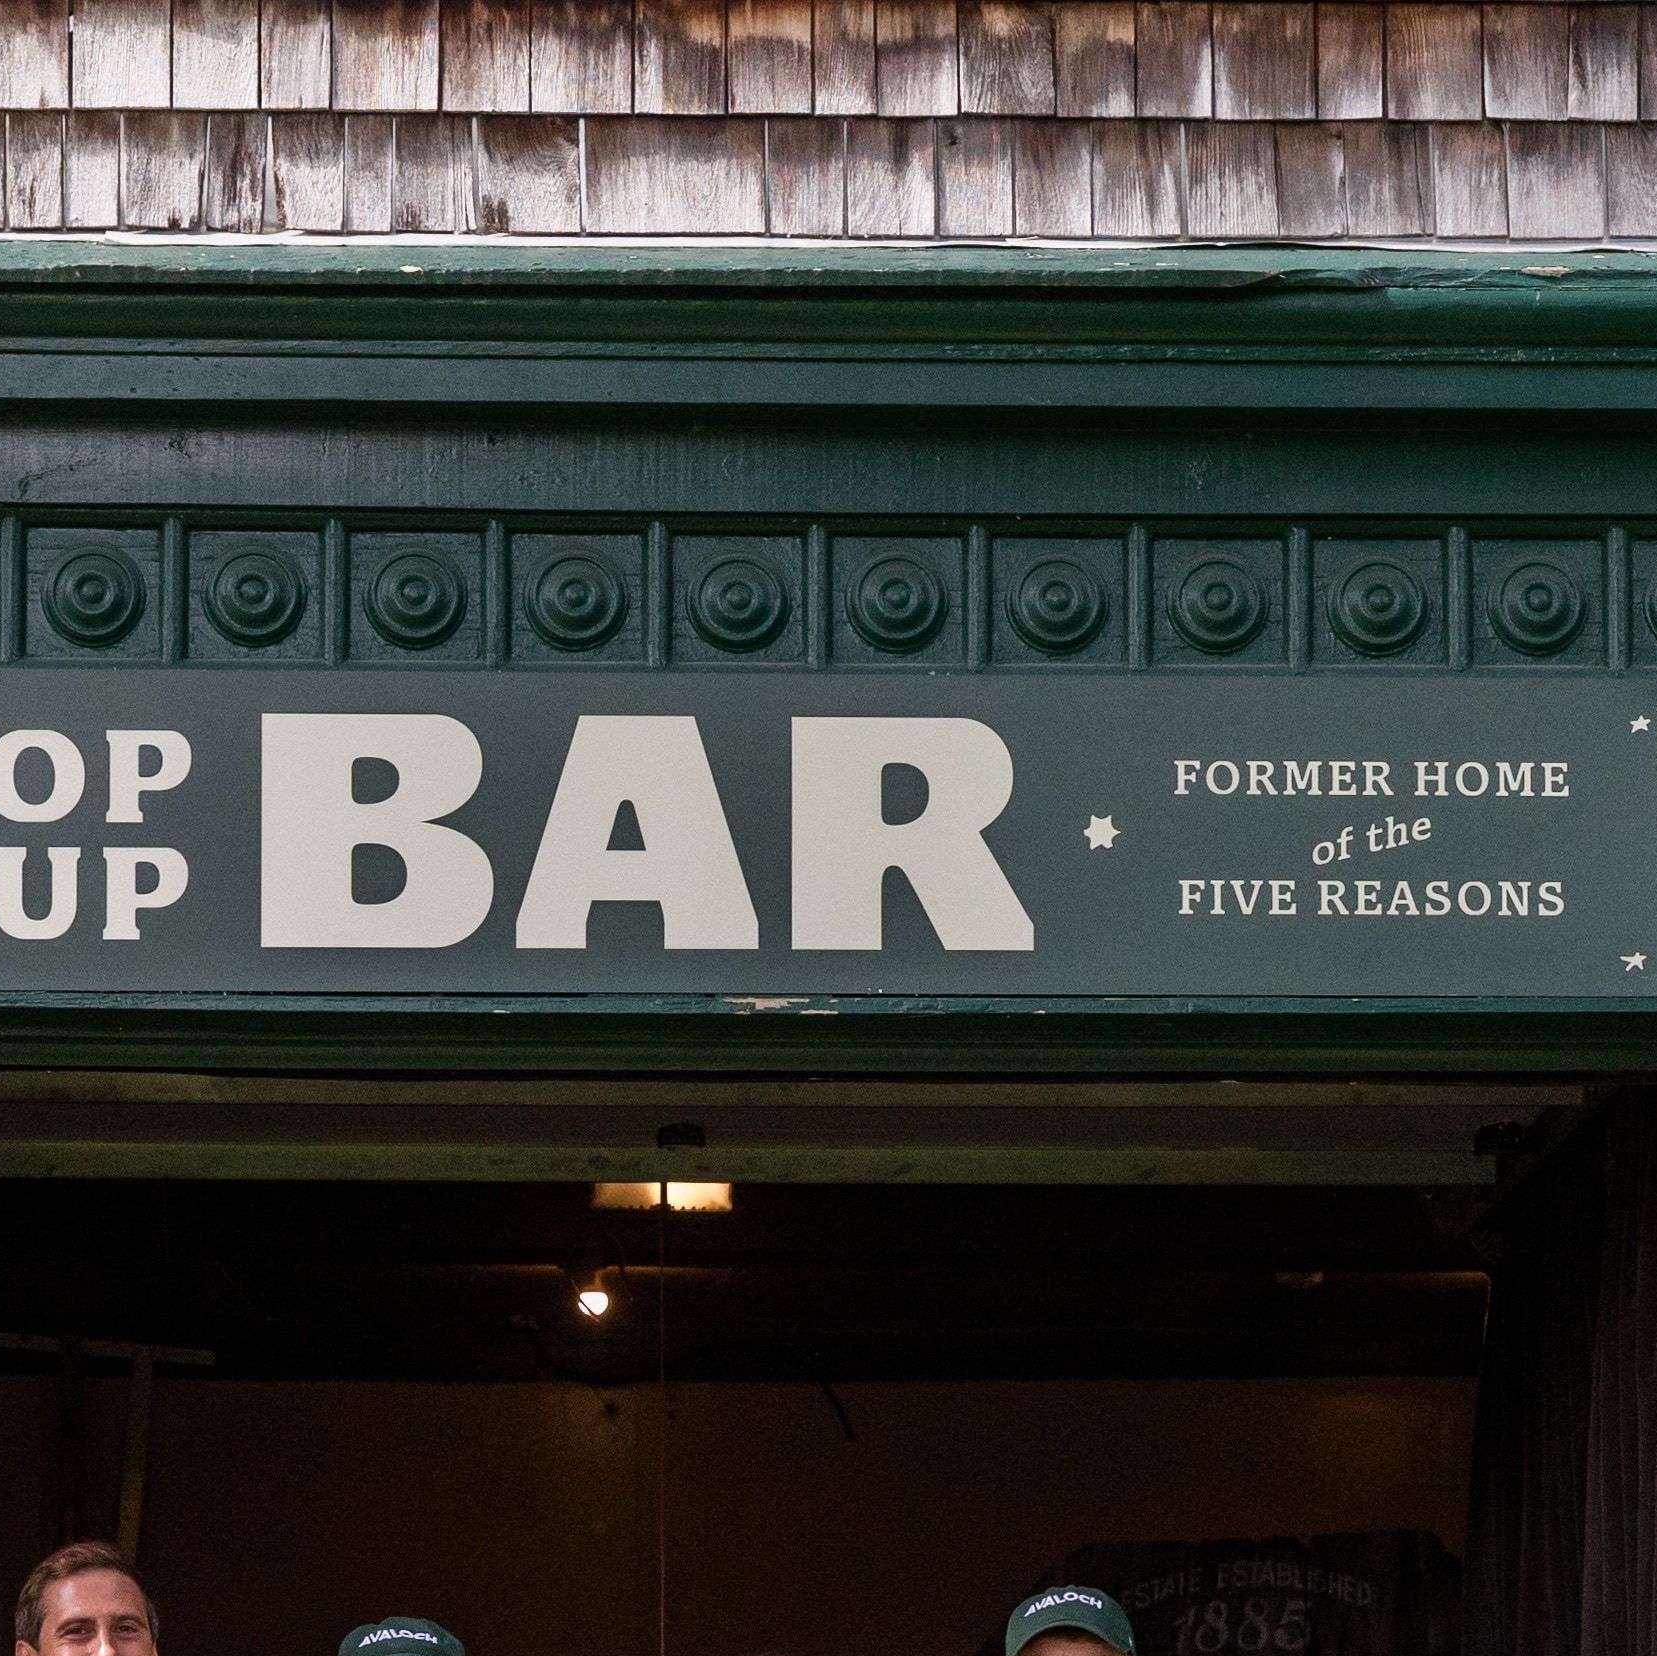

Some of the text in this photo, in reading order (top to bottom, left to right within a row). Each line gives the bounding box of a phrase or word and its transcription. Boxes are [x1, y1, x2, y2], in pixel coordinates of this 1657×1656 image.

[1173, 759, 1571, 798] FORMER HOME
[259, 712, 1036, 951] BAR
[1311, 815, 1432, 866] of the
[1177, 879, 1566, 917] FIVE REASONS
[1024, 1591, 1103, 1618] AVALOCH
[1216, 1560, 1375, 1608] ESTABLISHED
[358, 1628, 438, 1648] AVALOCH
[1174, 1598, 1311, 1655] 1885
